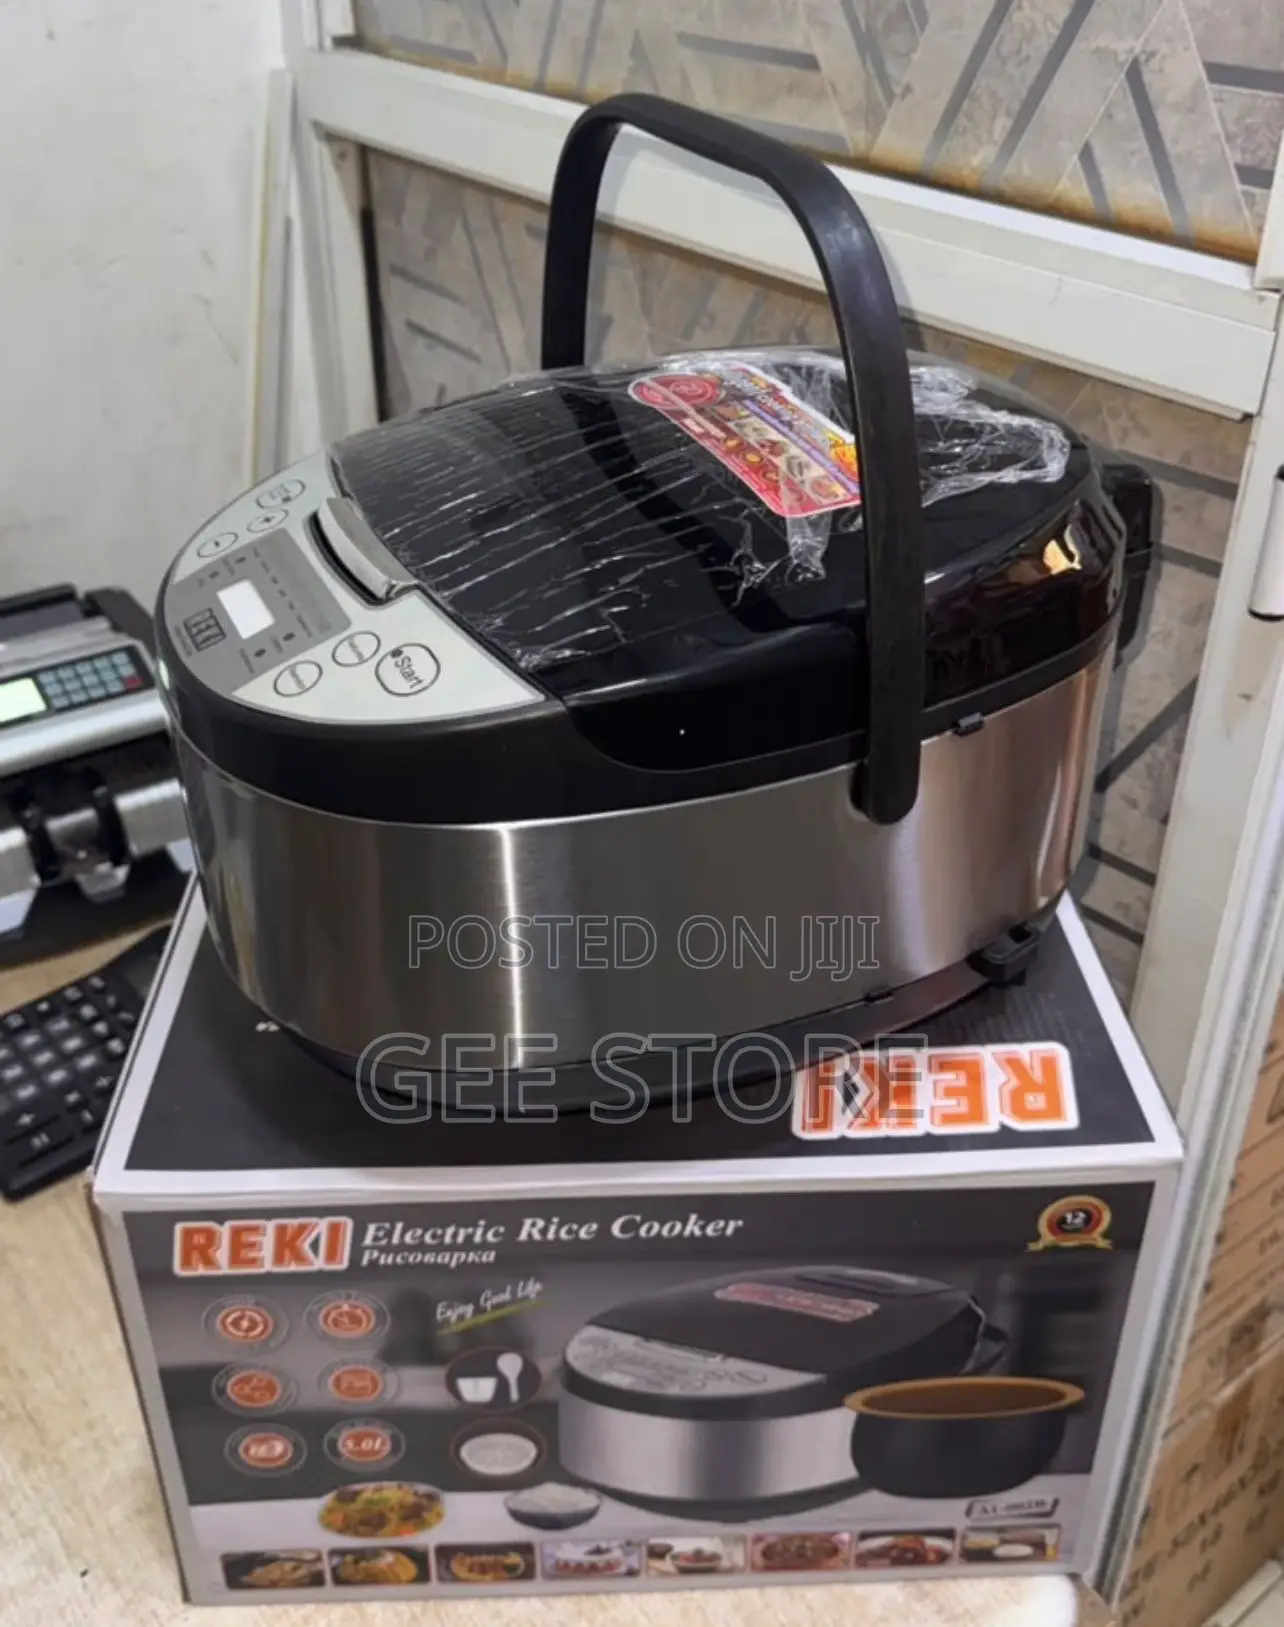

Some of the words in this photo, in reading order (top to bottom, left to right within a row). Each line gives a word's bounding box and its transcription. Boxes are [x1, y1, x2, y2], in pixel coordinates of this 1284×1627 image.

[393, 655, 424, 691] Start
[793, 1043, 1080, 1140] REKI
[174, 1216, 353, 1276] REKI
[362, 1219, 506, 1247] Electric
[517, 1216, 600, 1242] Rice
[610, 1213, 744, 1240] Cooker
[361, 1248, 497, 1269] Рисоварка
